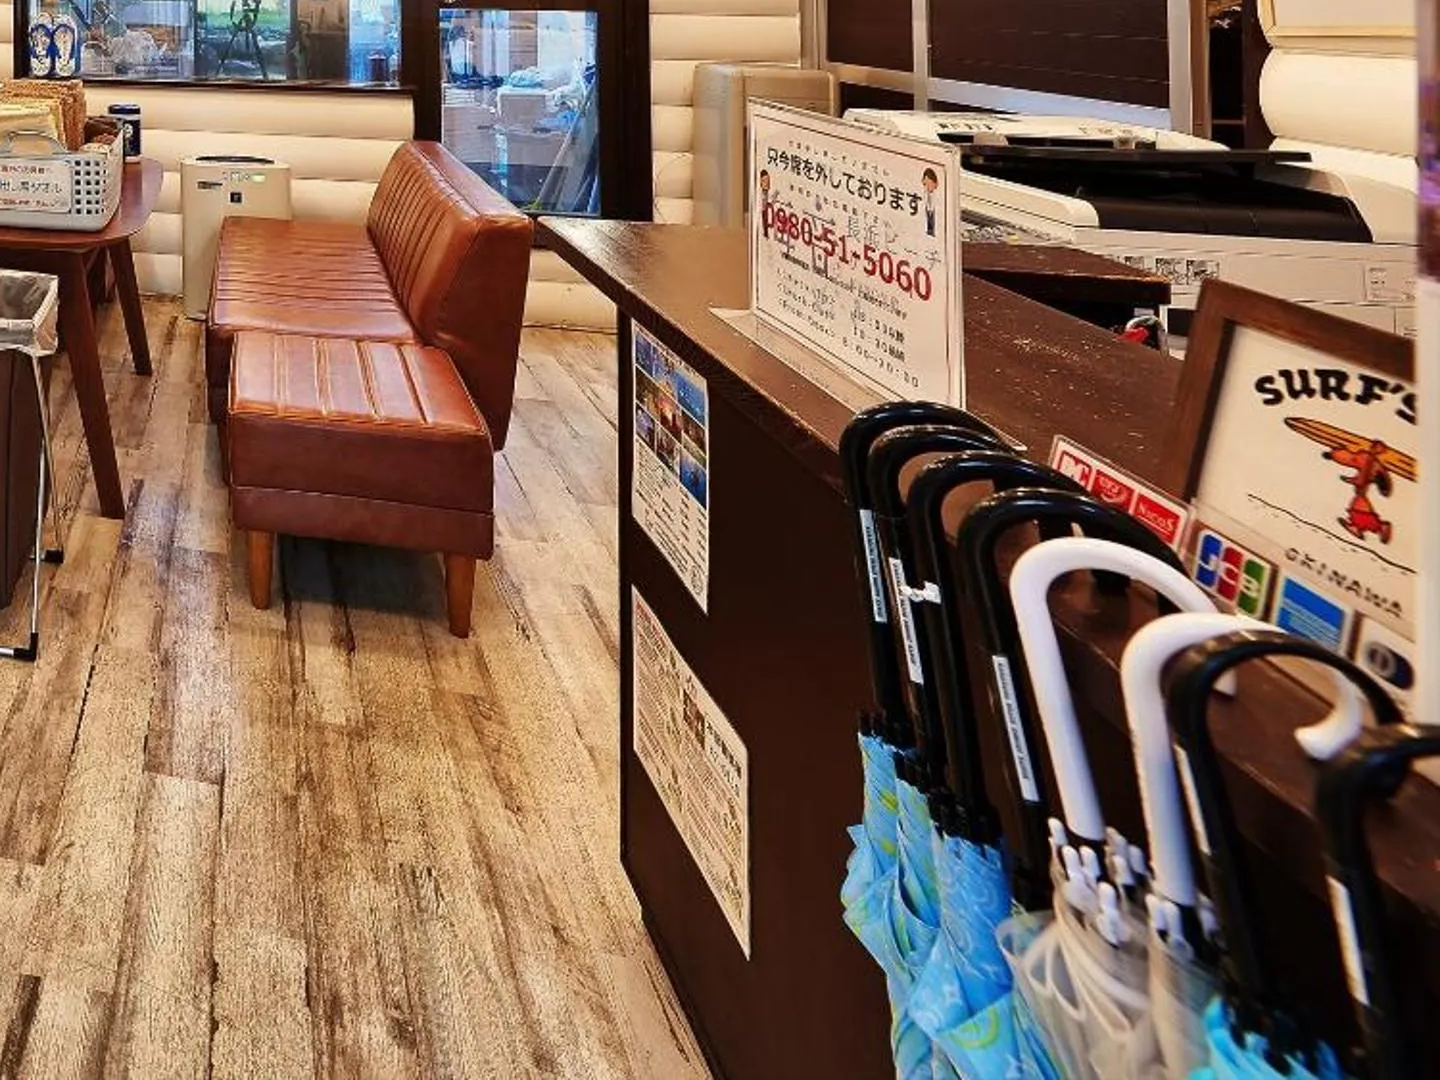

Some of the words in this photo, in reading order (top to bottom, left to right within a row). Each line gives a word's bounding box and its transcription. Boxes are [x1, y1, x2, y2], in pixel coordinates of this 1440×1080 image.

[766, 146, 923, 217] 只今席を外しております
[763, 201, 933, 302] 0980-51-5060
[1284, 545, 1404, 619] OKINAWA
